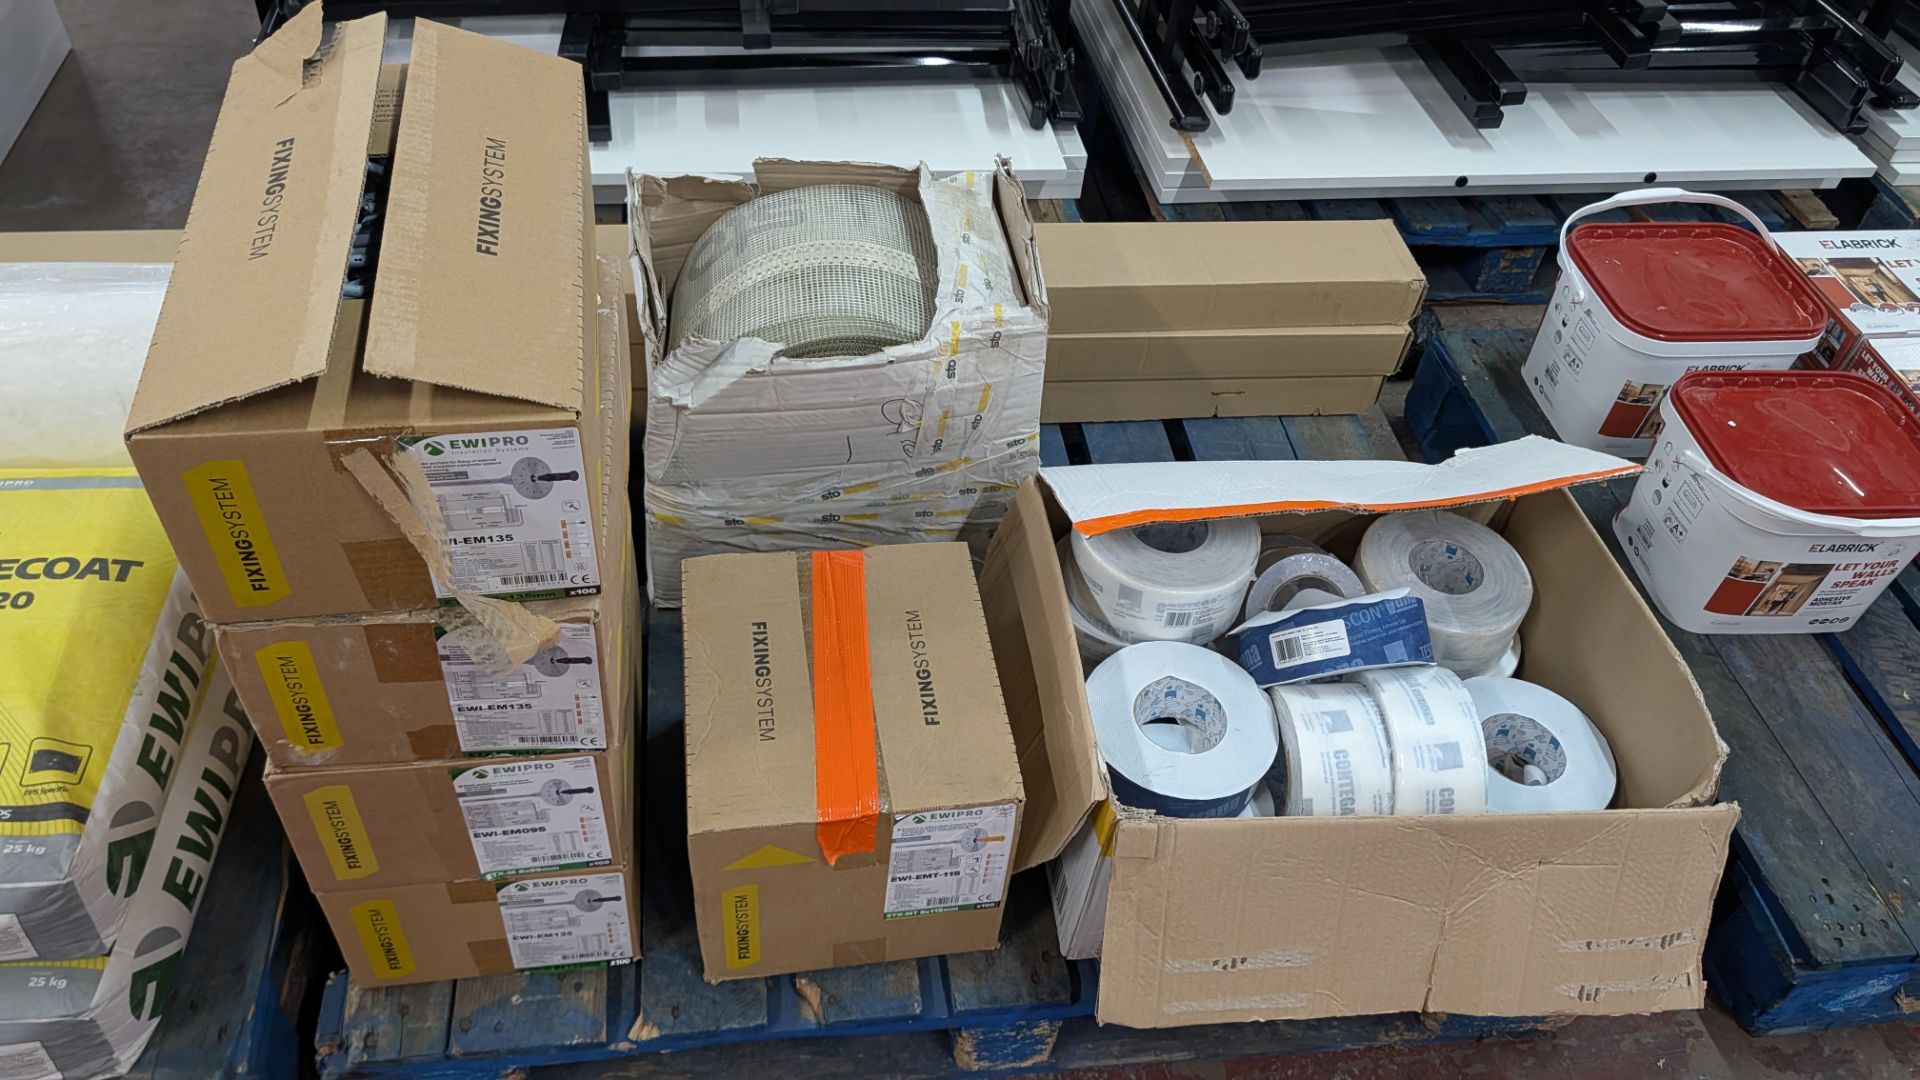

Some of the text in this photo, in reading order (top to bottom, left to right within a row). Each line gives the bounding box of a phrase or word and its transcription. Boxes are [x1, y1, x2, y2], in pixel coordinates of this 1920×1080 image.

[248, 137, 295, 262] FIXINGSYSTEM
[475, 137, 508, 257] FIXINGSYSTEM
[1819, 239, 1901, 250] ELABRICK
[1885, 259, 1914, 268] LET
[990, 331, 1001, 348] sto
[945, 360, 957, 379] sto
[1861, 350, 1890, 383] LET YOUR
[971, 414, 983, 430] sto
[449, 435, 529, 449] EWIPRO
[1006, 438, 1026, 449] sto
[914, 466, 935, 478] sto
[821, 490, 841, 501] sto
[958, 487, 977, 496] sto
[821, 512, 841, 522] sto
[915, 510, 934, 518] sto
[724, 518, 745, 526] sto
[211, 477, 269, 592] FIXINGSYSTEM
[449, 533, 514, 546] I-EM135
[1808, 543, 1881, 553] ELABRICK
[1834, 560, 1899, 571] LET YOUR
[1852, 568, 1898, 579] WALLS
[1831, 578, 1877, 589] SPEAK
[569, 587, 597, 596] x100
[905, 610, 940, 726] FIXINGSYSTEM
[752, 621, 776, 742] FIXINGSYSTEM
[276, 655, 325, 746] FIXINGSYSTEM
[492, 763, 555, 775] EWIPRO
[930, 809, 984, 820] EWIPRO
[322, 800, 363, 871] FIXINGSYSTEM
[473, 826, 547, 839] EWI-EM095
[3, 844, 46, 855] 25 kg
[532, 878, 589, 888] EWIPRO
[890, 871, 961, 883] EWI-EMT-115
[735, 894, 750, 960] FIXINGSYSTEM
[368, 909, 403, 971] FIXINGSYSTEM
[28, 976, 67, 989] 25 kg
